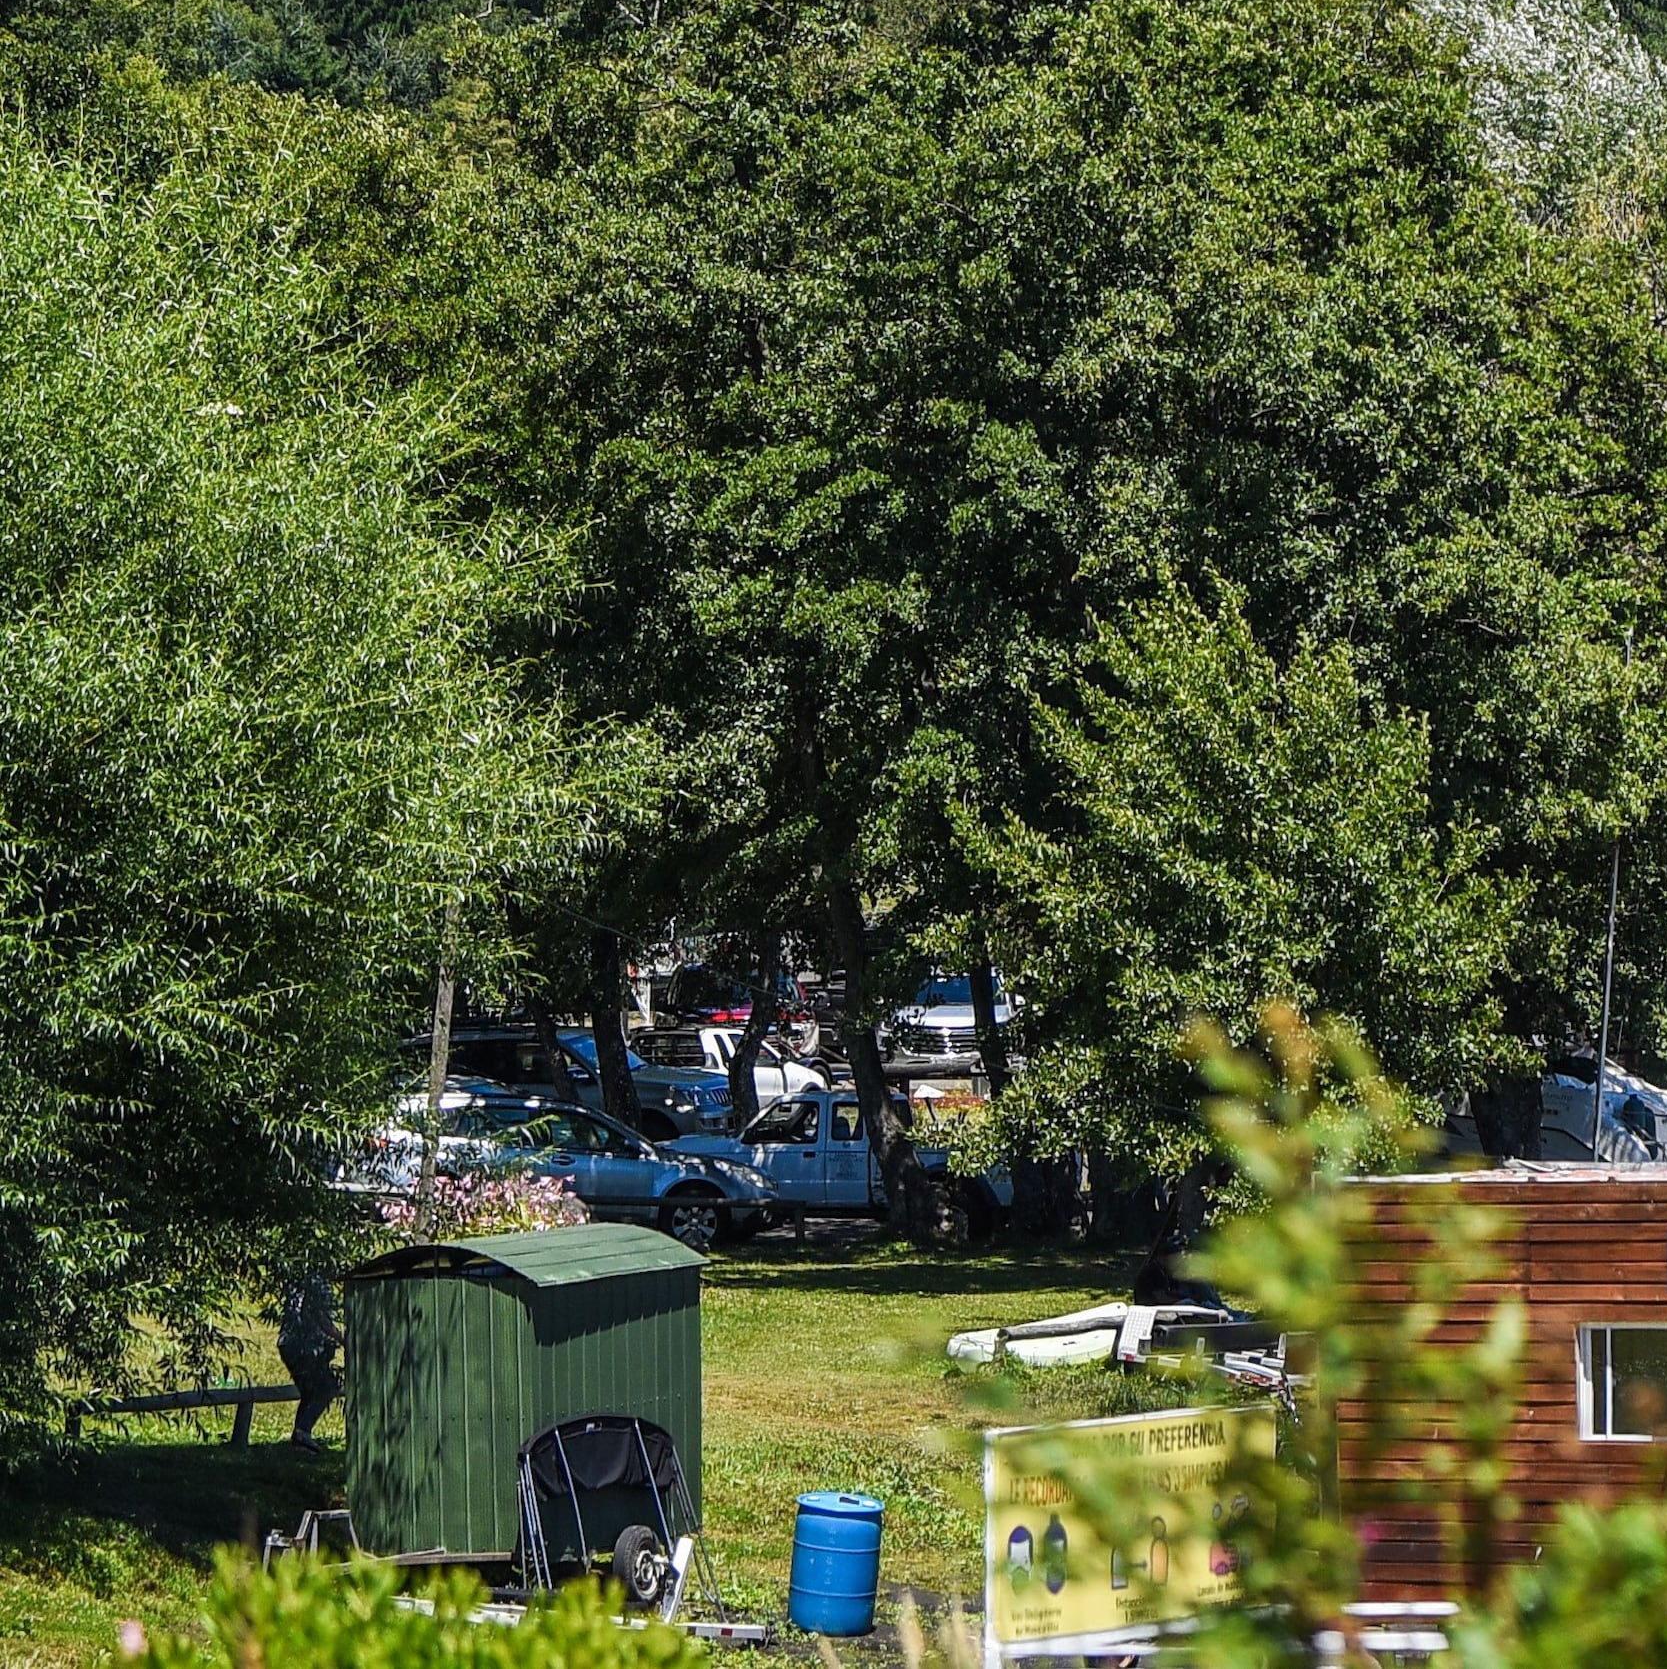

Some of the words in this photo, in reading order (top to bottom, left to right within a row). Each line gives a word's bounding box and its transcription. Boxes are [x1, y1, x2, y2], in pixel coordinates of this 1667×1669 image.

[1130, 1429, 1146, 1457] SU
[1149, 1420, 1227, 1455] PREFERENCIA
[1009, 1477, 1020, 1505] LE
